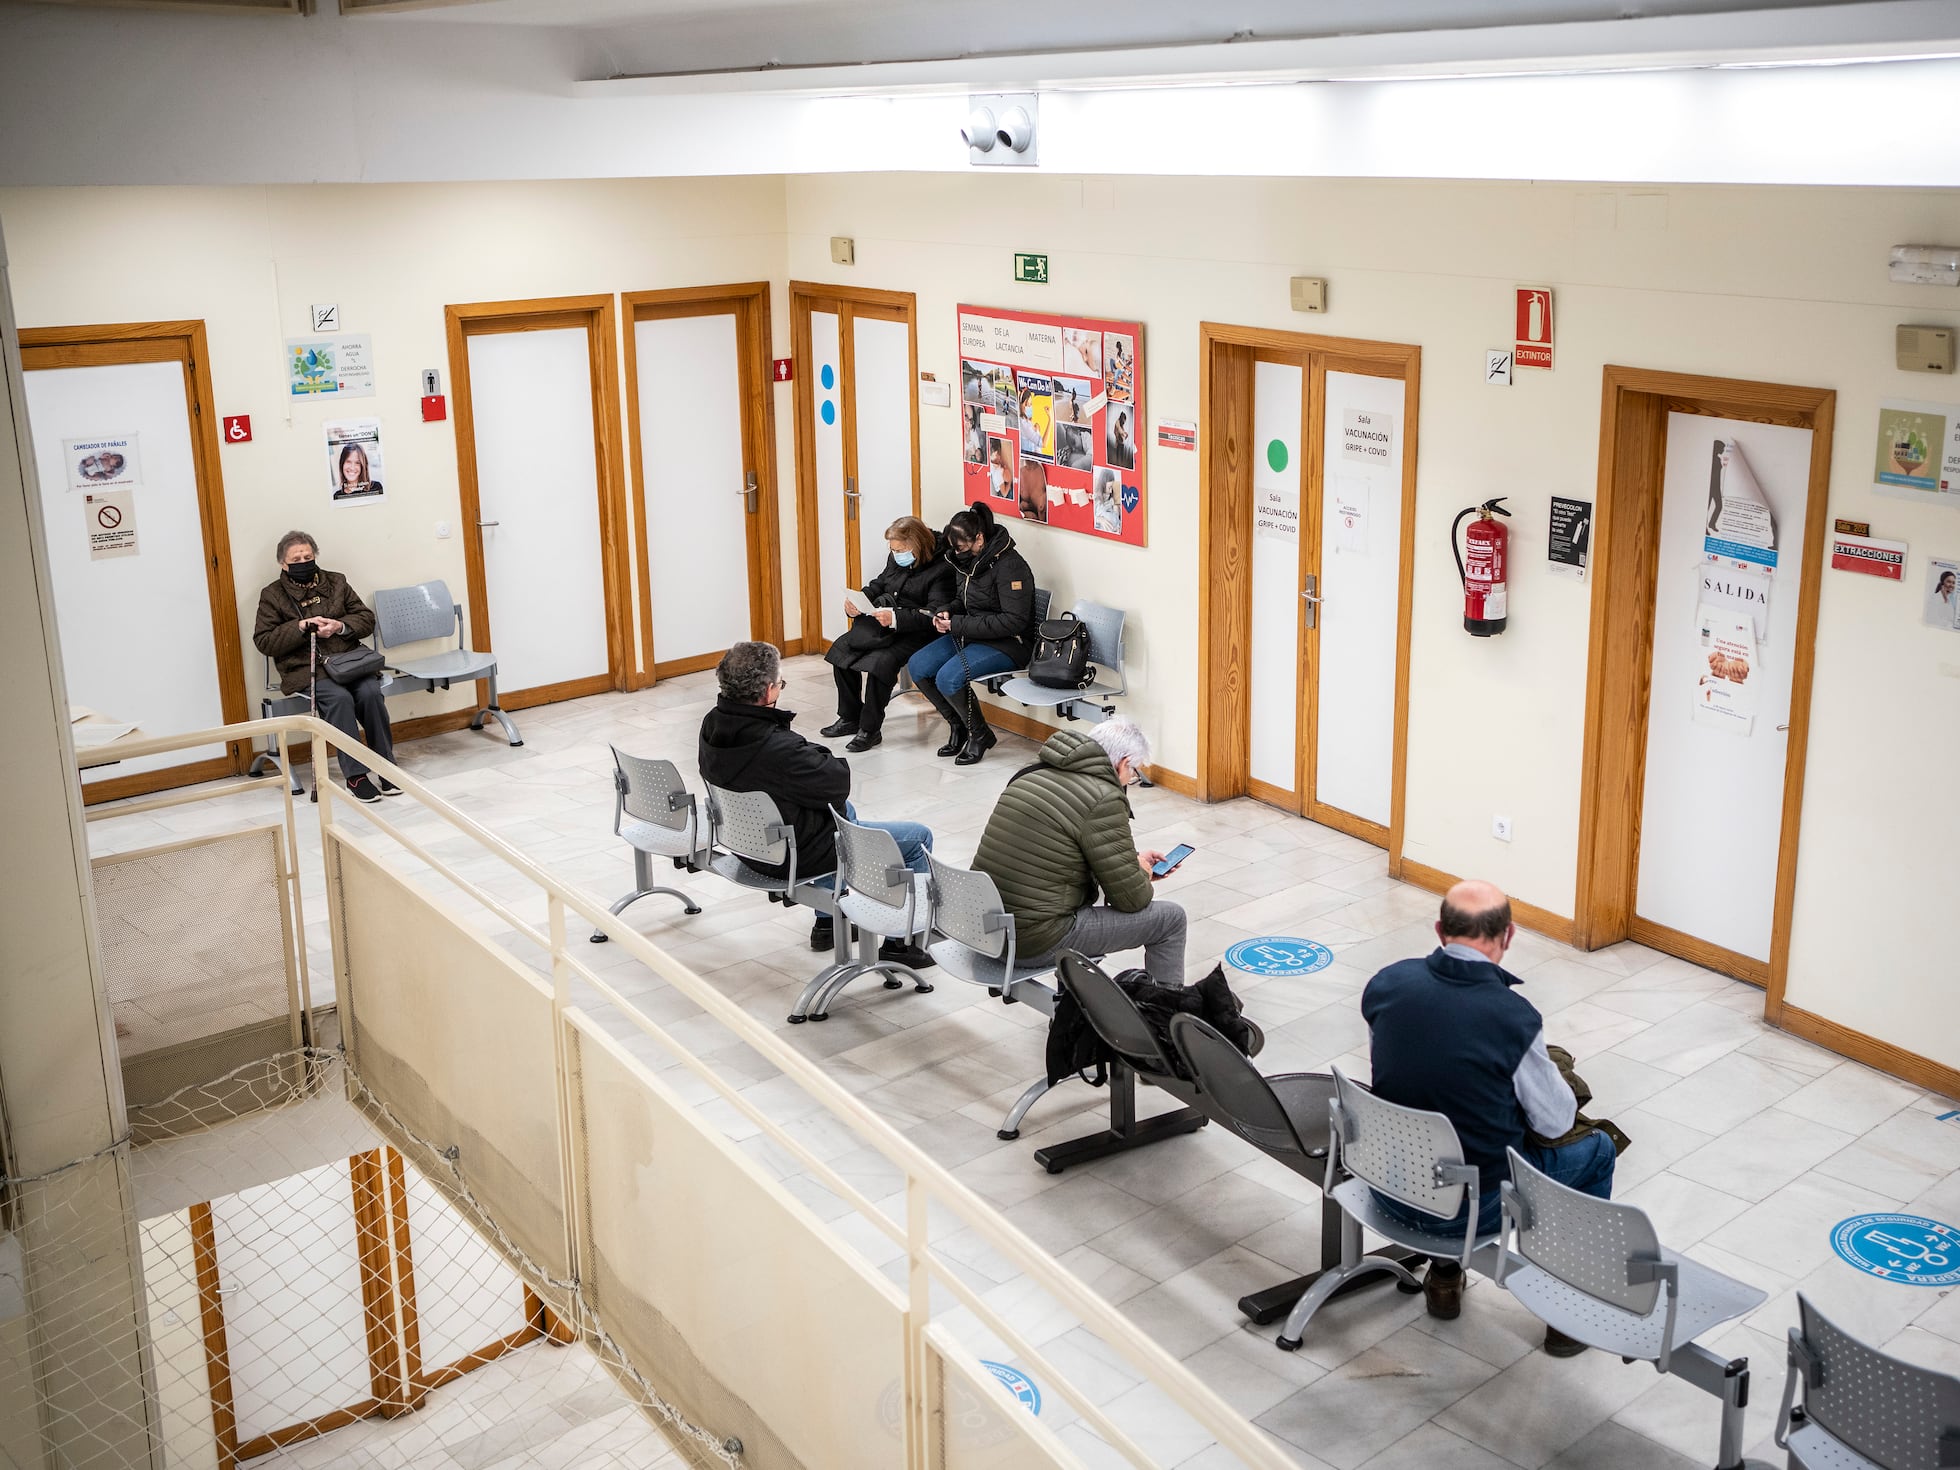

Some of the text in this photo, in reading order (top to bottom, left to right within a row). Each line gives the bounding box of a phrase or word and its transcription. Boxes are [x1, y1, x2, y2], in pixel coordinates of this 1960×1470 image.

[962, 322, 984, 333] SEMANA
[994, 327, 1010, 337] DE LA
[962, 336, 986, 348] EUROPEA
[1028, 332, 1056, 344] MATERNA
[996, 342, 1024, 354] LACTANCIA
[1516, 350, 1551, 362] EXTINTOR
[1027, 378, 1038, 390] Can
[1038, 380, 1045, 392] Do
[1358, 415, 1370, 424] Sala
[1344, 428, 1388, 442] VACUNACIÓN
[1346, 442, 1362, 452] GRIPE
[1368, 446, 1387, 456] COVID
[1270, 494, 1281, 502] Sala
[1553, 502, 1582, 512] PREVECOLON
[1258, 520, 1273, 528] GRIPE
[1279, 524, 1296, 533] COVID
[1834, 544, 1901, 562] EXTRACCIONES
[1704, 578, 1765, 604] SALIDA
[1874, 1216, 1930, 1227] SEGURIDAD
